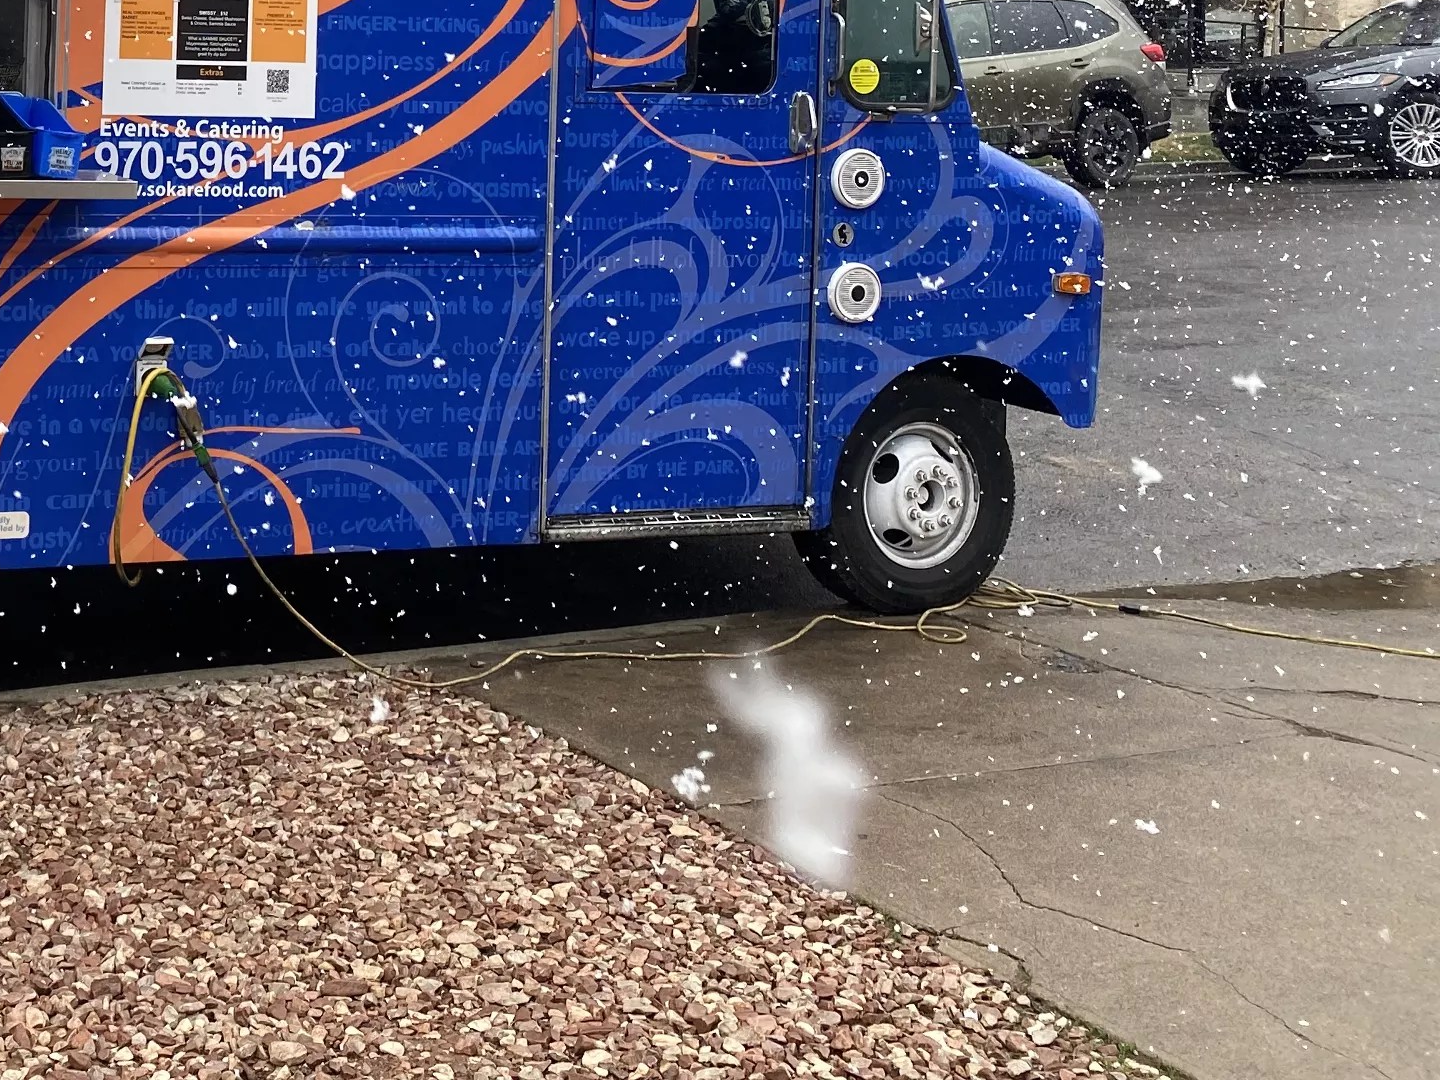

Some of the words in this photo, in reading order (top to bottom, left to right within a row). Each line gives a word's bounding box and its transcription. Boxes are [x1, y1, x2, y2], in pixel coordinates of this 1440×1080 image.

[200, 67, 224, 77] Extras
[99, 117, 170, 138] Events
[174, 118, 191, 138] &
[195, 119, 284, 143] Catering
[481, 133, 547, 164] pushin
[15, 524, 26, 534] by
